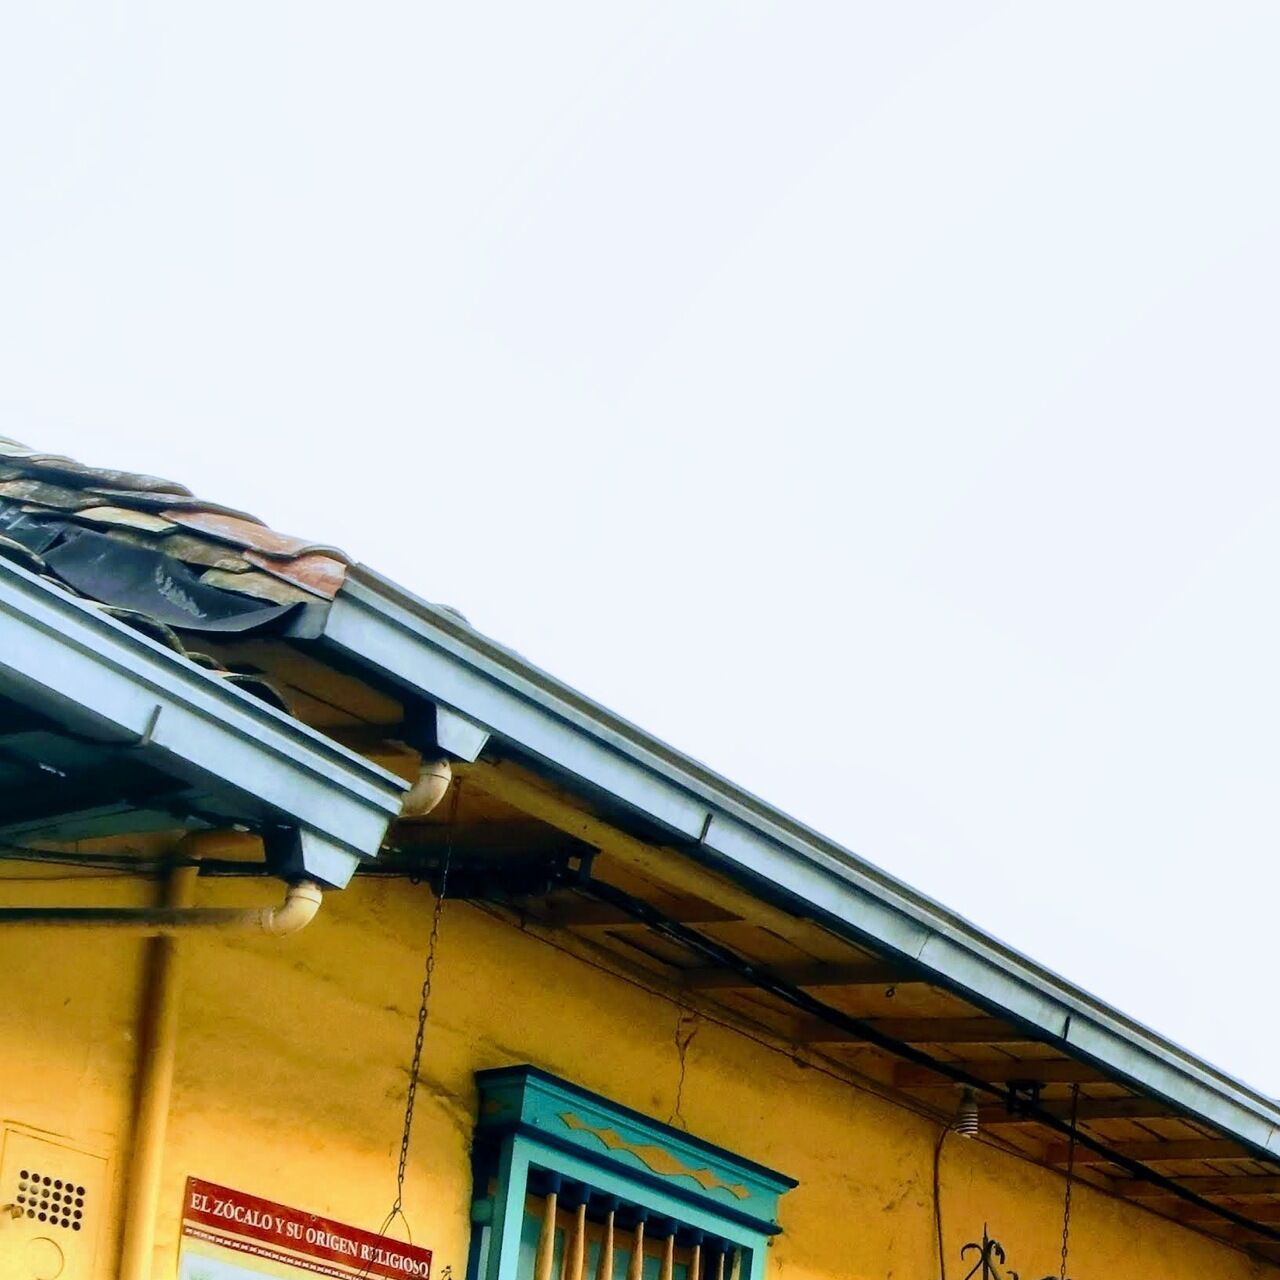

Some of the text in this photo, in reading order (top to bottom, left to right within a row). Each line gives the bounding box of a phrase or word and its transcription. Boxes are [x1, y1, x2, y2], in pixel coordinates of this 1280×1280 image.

[191, 1193, 429, 1279] EL ZÓCALO Y SU ORIGEN RELIGIOSO
